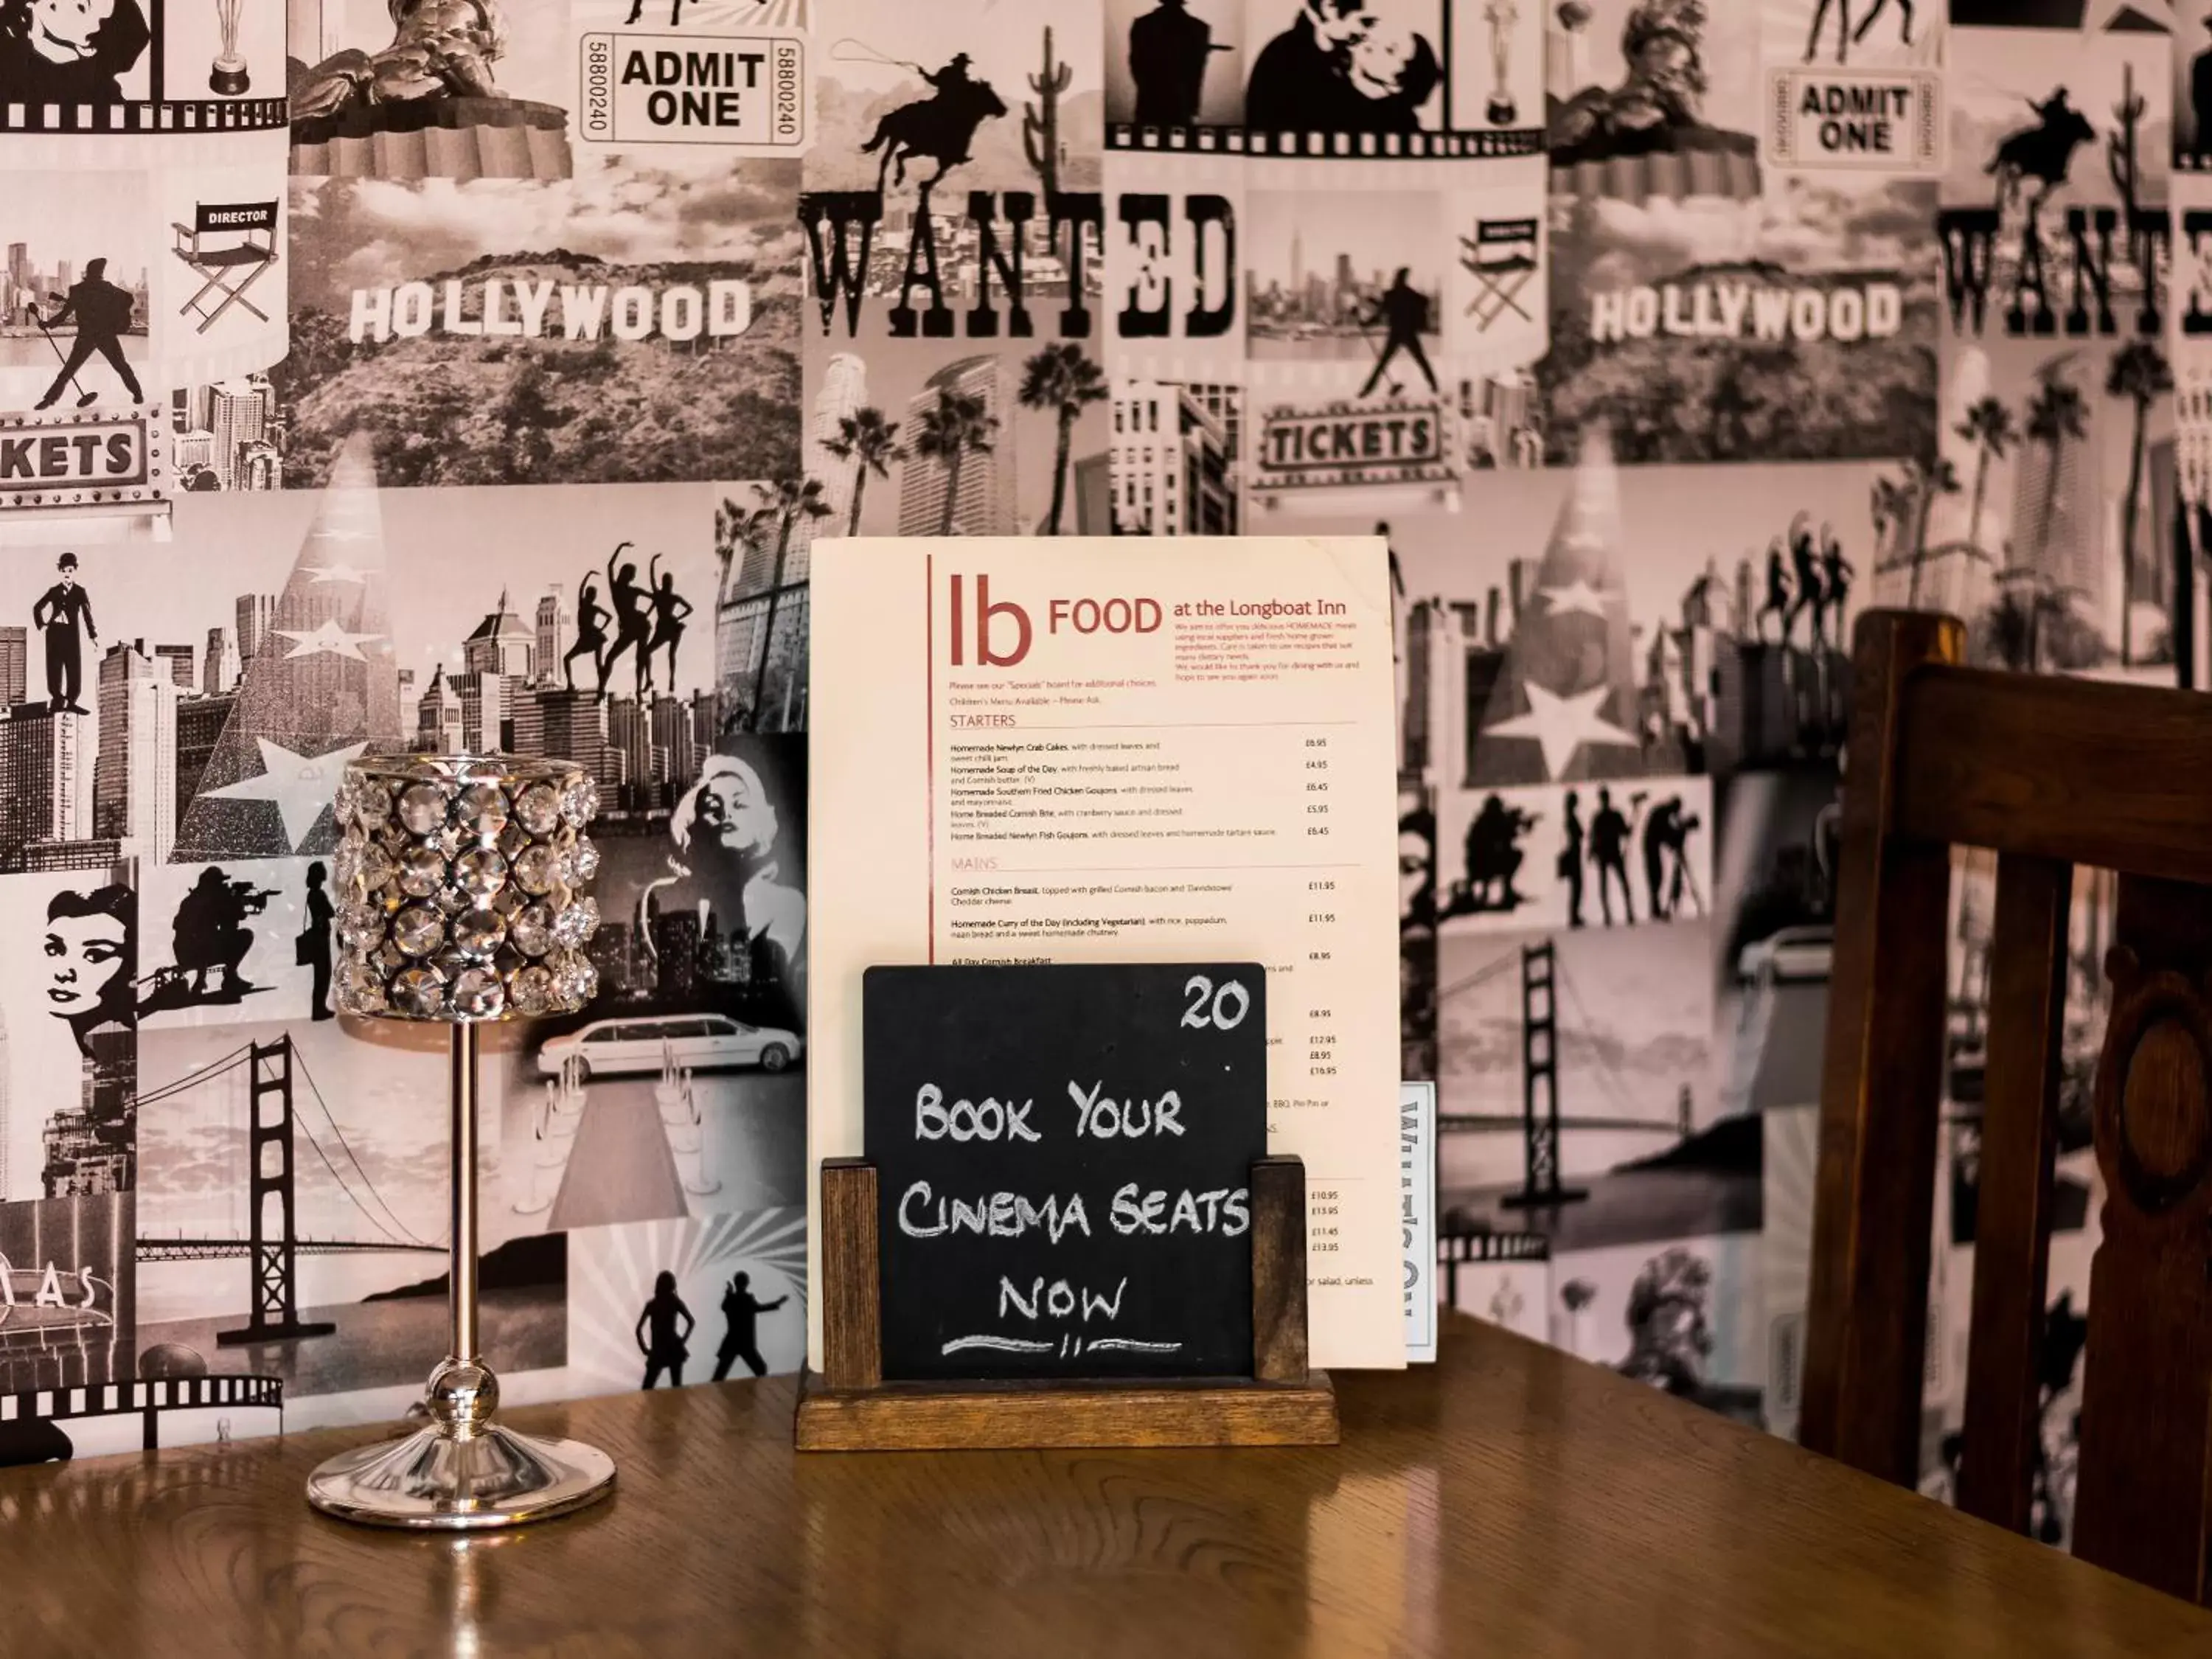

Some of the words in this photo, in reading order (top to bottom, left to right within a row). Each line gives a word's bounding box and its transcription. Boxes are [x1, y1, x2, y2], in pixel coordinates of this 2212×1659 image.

[588, 42, 607, 131] 58800240
[622, 51, 764, 88] ADMIT
[778, 47, 795, 135] 58800240
[1801, 84, 1910, 118] ADMIT
[647, 91, 740, 126] ONE
[1819, 122, 1893, 153] ONE
[208, 209, 268, 225] DIRECTOR
[797, 191, 1237, 338] WANTED
[349, 279, 751, 344] HOLLYWOOD
[1590, 282, 1900, 343] HOLLYWOOD
[1271, 418, 1430, 462] TICKETS
[950, 574, 1032, 667] lb
[1049, 598, 1163, 634] FOOD
[1174, 603, 1192, 617] at
[1196, 599, 1225, 616] the
[1230, 598, 1312, 620] Longboat
[1317, 599, 1346, 616] Inn
[950, 714, 1016, 727] STARTERS
[950, 743, 995, 752] Homemade
[1026, 742, 1045, 751] Crab
[950, 765, 995, 774] Homemade
[996, 765, 1015, 775] Soup
[1017, 765, 1026, 773] of
[1027, 765, 1040, 773] the
[1157, 762, 1180, 771] bread
[950, 787, 995, 796] Homemade
[996, 787, 1032, 796] Southern
[1033, 787, 1052, 796] Fried
[1054, 786, 1084, 796] Chicken
[950, 810, 974, 818] Home
[975, 810, 1007, 818] Breaded
[1009, 809, 1038, 818] Cornish
[950, 832, 974, 841] Home
[975, 832, 1007, 840] Breaded
[1040, 831, 1055, 840] Fish
[951, 857, 999, 870] MAINS
[950, 887, 981, 896] Cornish
[982, 887, 1013, 895] Chicken
[1308, 880, 1336, 890] £11.95
[950, 919, 995, 928] Homemade
[998, 919, 1018, 929] Curry
[1020, 919, 1029, 927] of
[1030, 919, 1043, 927] the
[1045, 918, 1060, 928] Day
[1308, 914, 1335, 922] £11.95
[1181, 975, 1250, 1030] 20
[916, 1083, 1041, 1142] BOOK
[1068, 1079, 1186, 1138] YOUR
[898, 1180, 1091, 1245] CINEMA
[1110, 1183, 1250, 1237] SEATS
[1311, 1191, 1339, 1200] £10.95
[999, 1276, 1127, 1321] NOW
